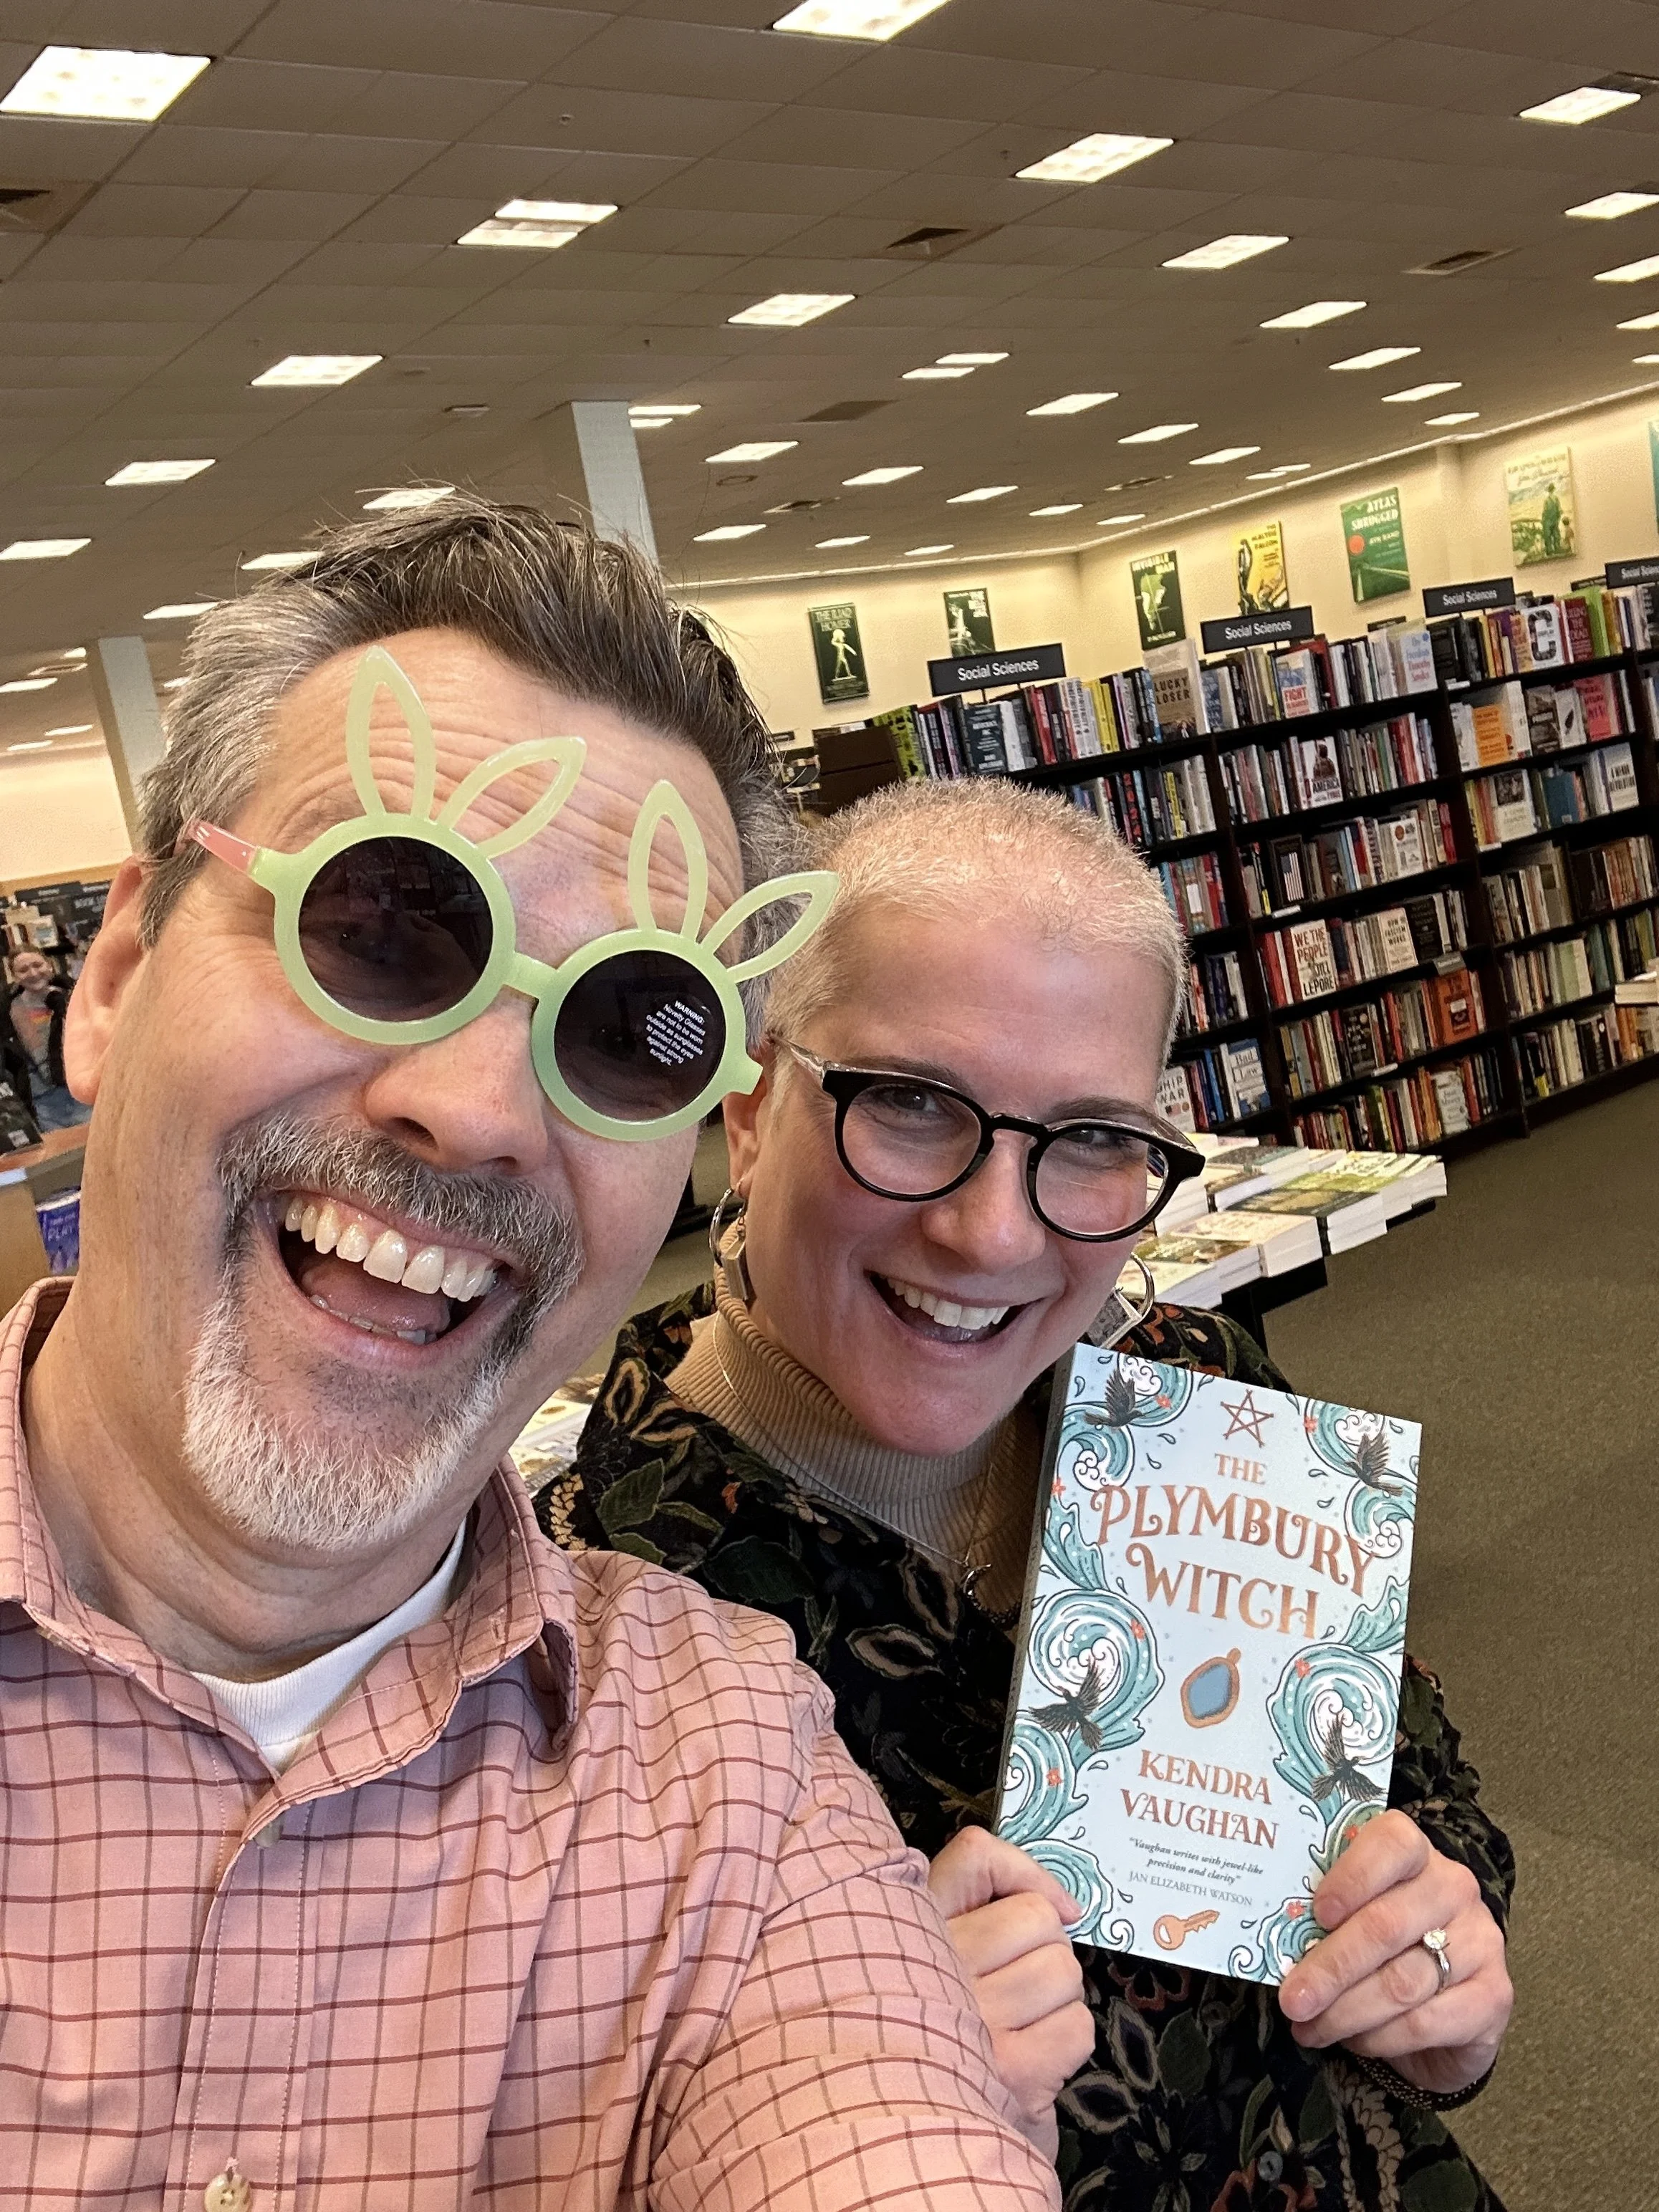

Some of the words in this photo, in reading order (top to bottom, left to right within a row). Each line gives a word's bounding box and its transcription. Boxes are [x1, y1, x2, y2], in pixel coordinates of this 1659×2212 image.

[1367, 494, 1397, 513] ATLAS
[1351, 509, 1399, 531] SHRUGGED
[1443, 592, 1465, 607] Social
[1465, 589, 1497, 604] Sciences
[815, 609, 832, 623] THE
[821, 618, 851, 632] HOMER
[1224, 625, 1253, 640] Social
[1253, 620, 1292, 635] Sciences
[957, 664, 991, 681] Social
[991, 659, 1039, 676] Sciences
[1153, 675, 1189, 693] LUCKY
[1155, 689, 1190, 705] LOSER
[1312, 777, 1340, 794] AMERICA
[1294, 931, 1310, 947] WE
[1311, 927, 1326, 943] THE
[1297, 943, 1329, 963] PEOPLE
[1303, 977, 1336, 997] LEPORE
[1236, 1051, 1254, 1064] Bad
[1240, 1067, 1258, 1082] Law
[1214, 1453, 1267, 1485] THE
[1090, 1484, 1375, 1597] PLYMBURY
[1125, 1542, 1319, 1639] WITCH
[1138, 1749, 1272, 1805] KENDRA
[1120, 1788, 1280, 1849] VAUGHAN
[1129, 1836, 1172, 1854] “Vaughan
[1173, 1849, 1200, 1861] writes
[1201, 1854, 1221, 1865] with
[1220, 1858, 1264, 1875] jewel-like
[1145, 1857, 1186, 1872] precision
[1188, 1866, 1206, 1877] and
[1207, 1870, 1242, 1885] clarity”
[1128, 1870, 1149, 1883] JAN
[1150, 1875, 1207, 1897] ELIZABETH
[1209, 1888, 1253, 1906] WATSON
